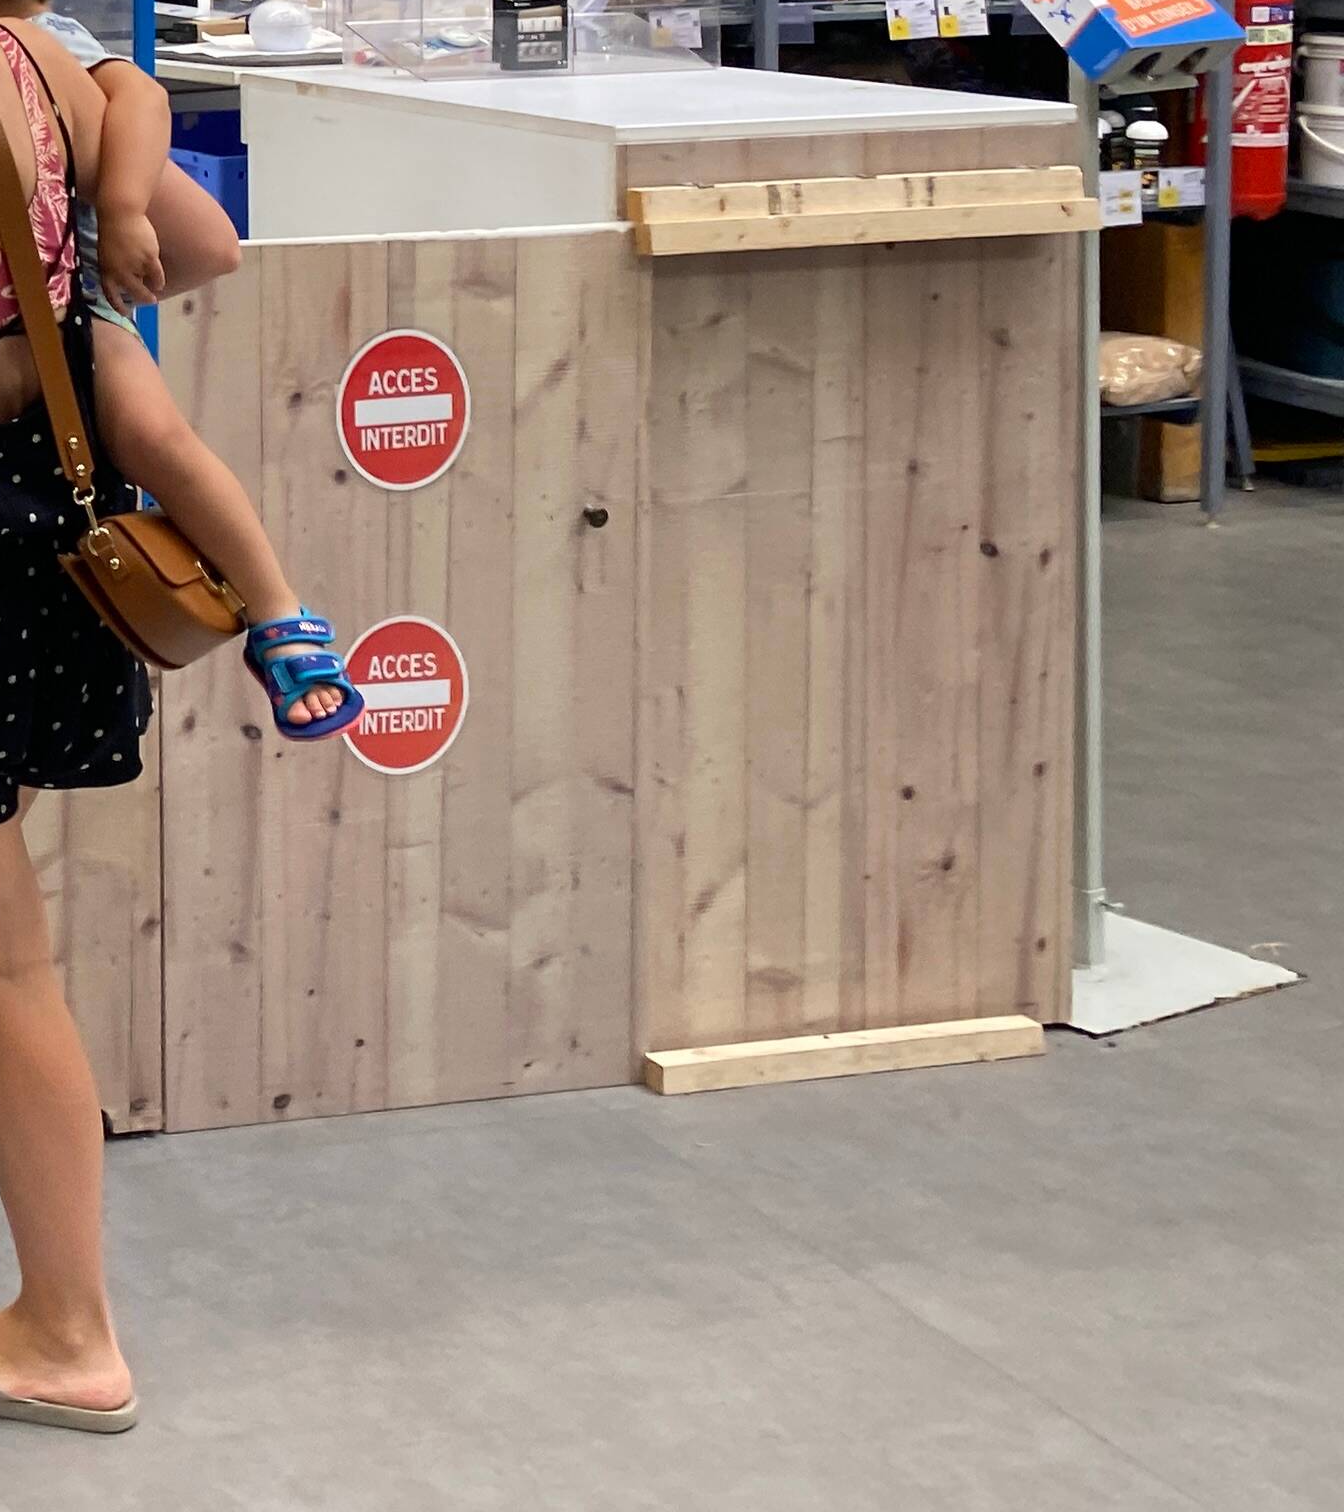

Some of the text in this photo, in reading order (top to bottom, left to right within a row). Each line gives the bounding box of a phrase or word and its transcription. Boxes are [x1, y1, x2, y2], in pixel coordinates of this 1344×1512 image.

[367, 367, 439, 397] ACCES
[360, 423, 449, 452] INTERDIT
[366, 652, 438, 681] ACCES
[358, 707, 446, 735] INTERDIT
